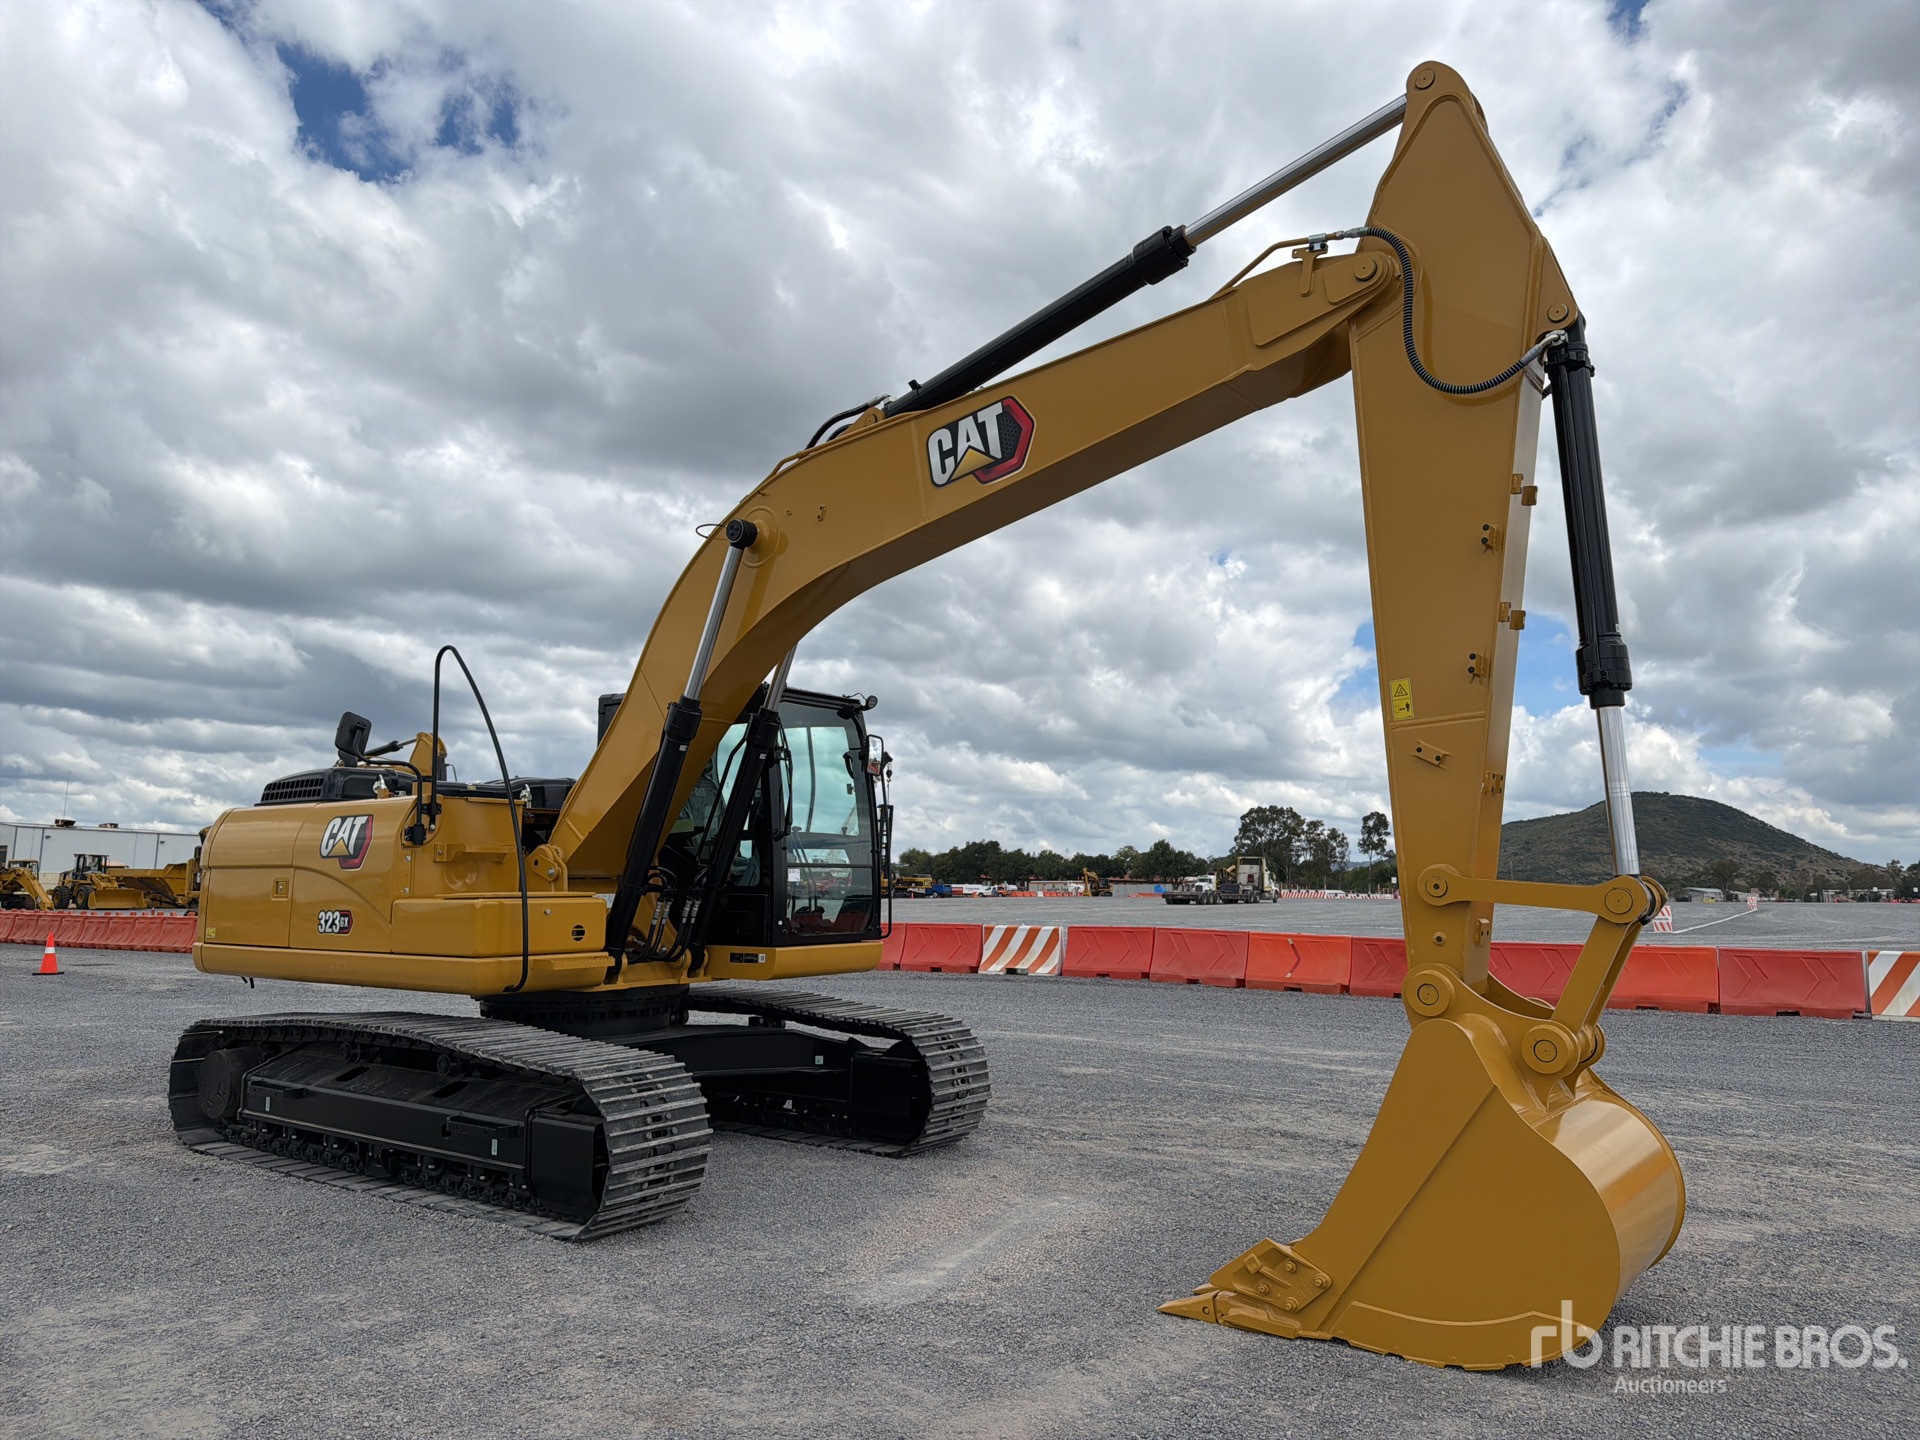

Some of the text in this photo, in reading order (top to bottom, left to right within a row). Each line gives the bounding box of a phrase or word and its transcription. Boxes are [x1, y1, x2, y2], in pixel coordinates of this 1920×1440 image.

[927, 401, 1003, 485] CAT
[320, 816, 368, 857] CAT
[318, 911, 340, 933] 323
